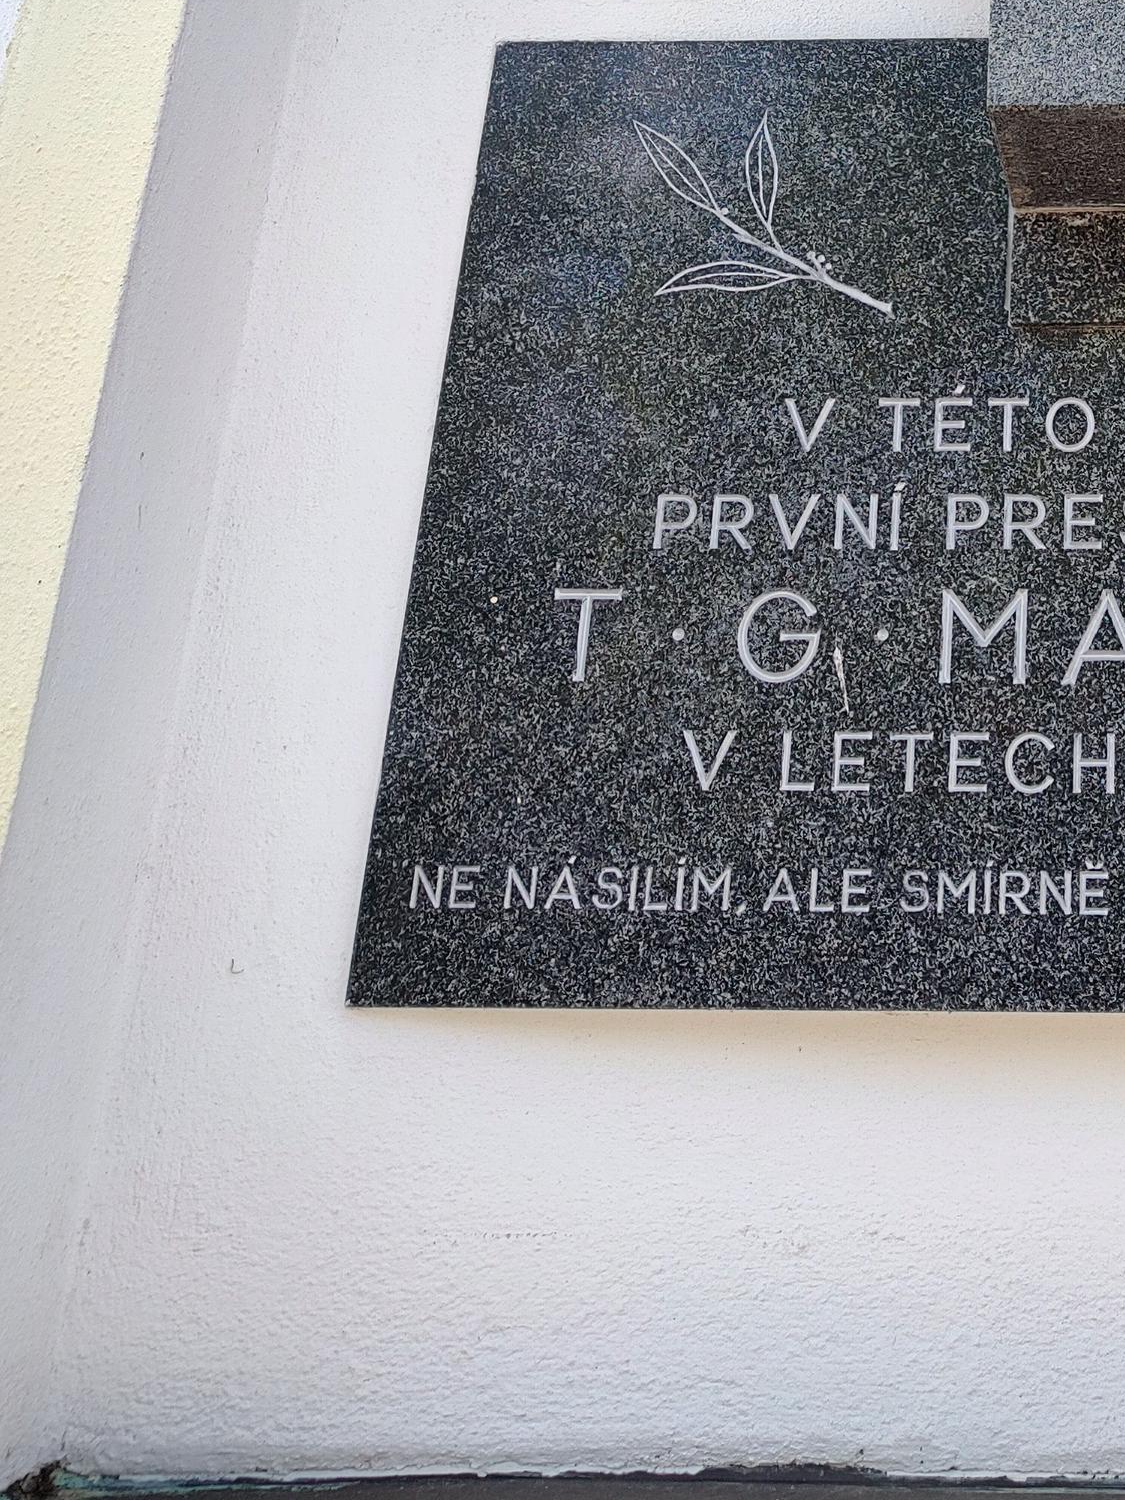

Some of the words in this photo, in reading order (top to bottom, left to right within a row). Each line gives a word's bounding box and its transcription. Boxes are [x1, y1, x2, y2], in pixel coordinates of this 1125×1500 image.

[785, 397, 837, 453] V
[878, 384, 1098, 453] TÉTO
[652, 481, 907, 551] PRVNÍ
[683, 729, 737, 792] V
[780, 730, 1116, 795] LETECH
[408, 864, 482, 911] NE
[503, 856, 749, 916] NÁSILÍM,
[762, 867, 873, 915] ALE
